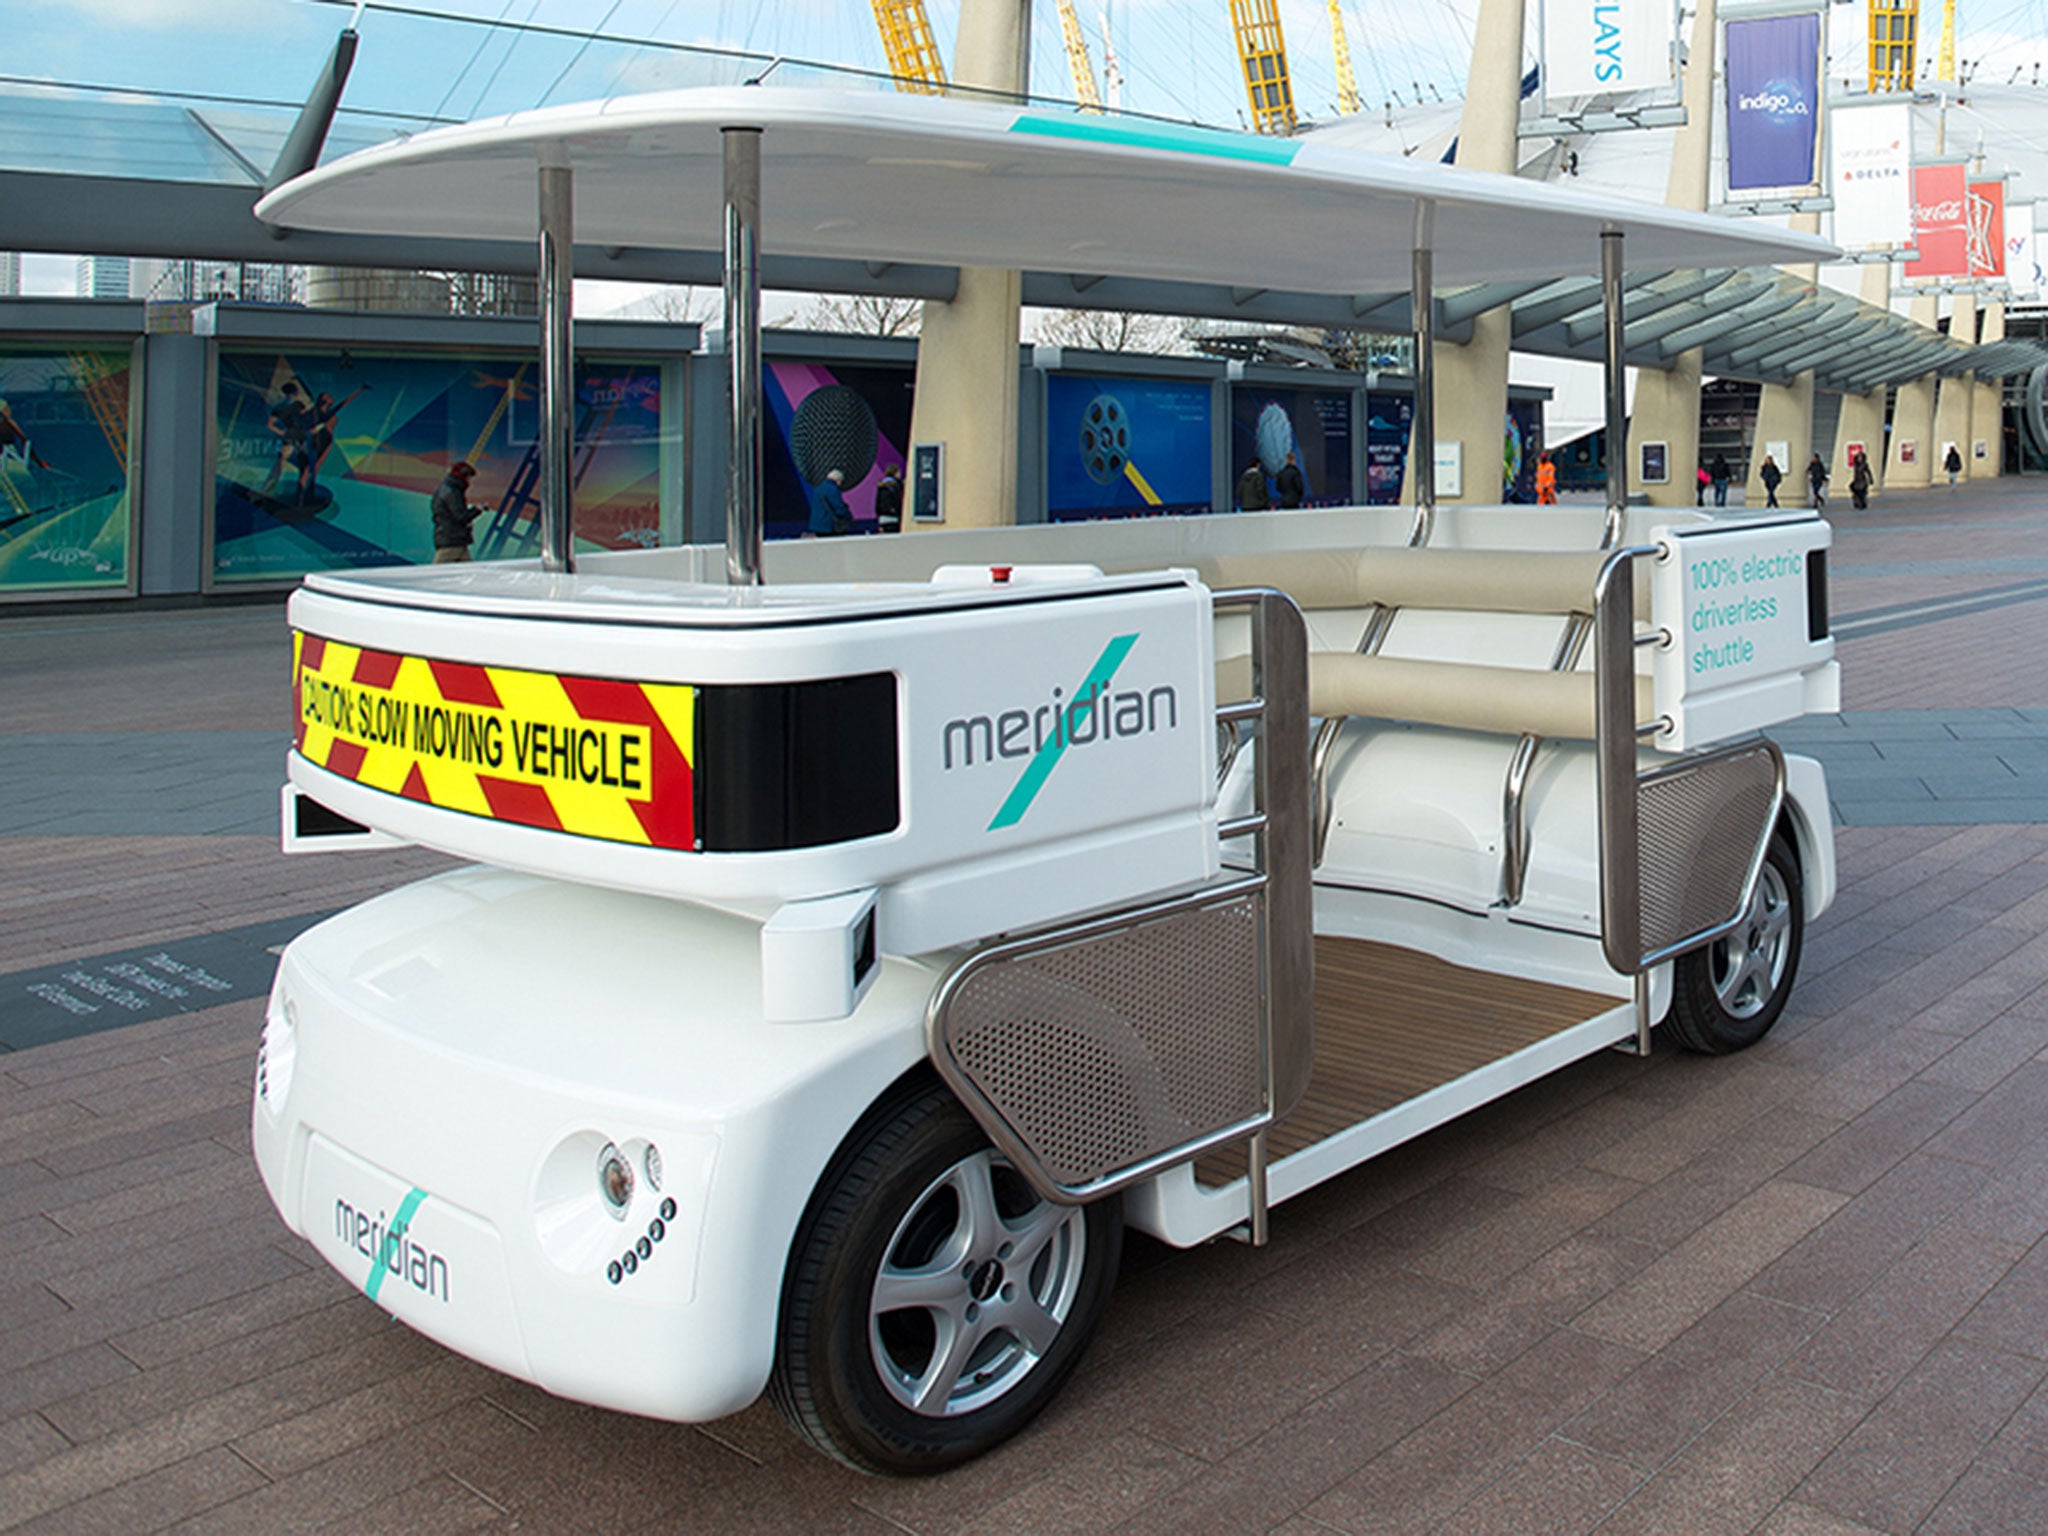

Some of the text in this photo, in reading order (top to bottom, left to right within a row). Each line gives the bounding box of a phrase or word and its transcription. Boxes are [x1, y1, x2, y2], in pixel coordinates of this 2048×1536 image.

[1594, 0, 1622, 82] LAYS
[1739, 92, 1789, 112] indigo
[1691, 549, 1802, 590] 100% electric
[1692, 595, 1777, 632] driverless
[1693, 636, 1754, 673] shuttle
[358, 691, 408, 748] SLOW
[413, 703, 502, 768] MOVING
[511, 719, 641, 790] VEHICLE
[943, 679, 1177, 771] meridian
[336, 1198, 449, 1302] meridian
